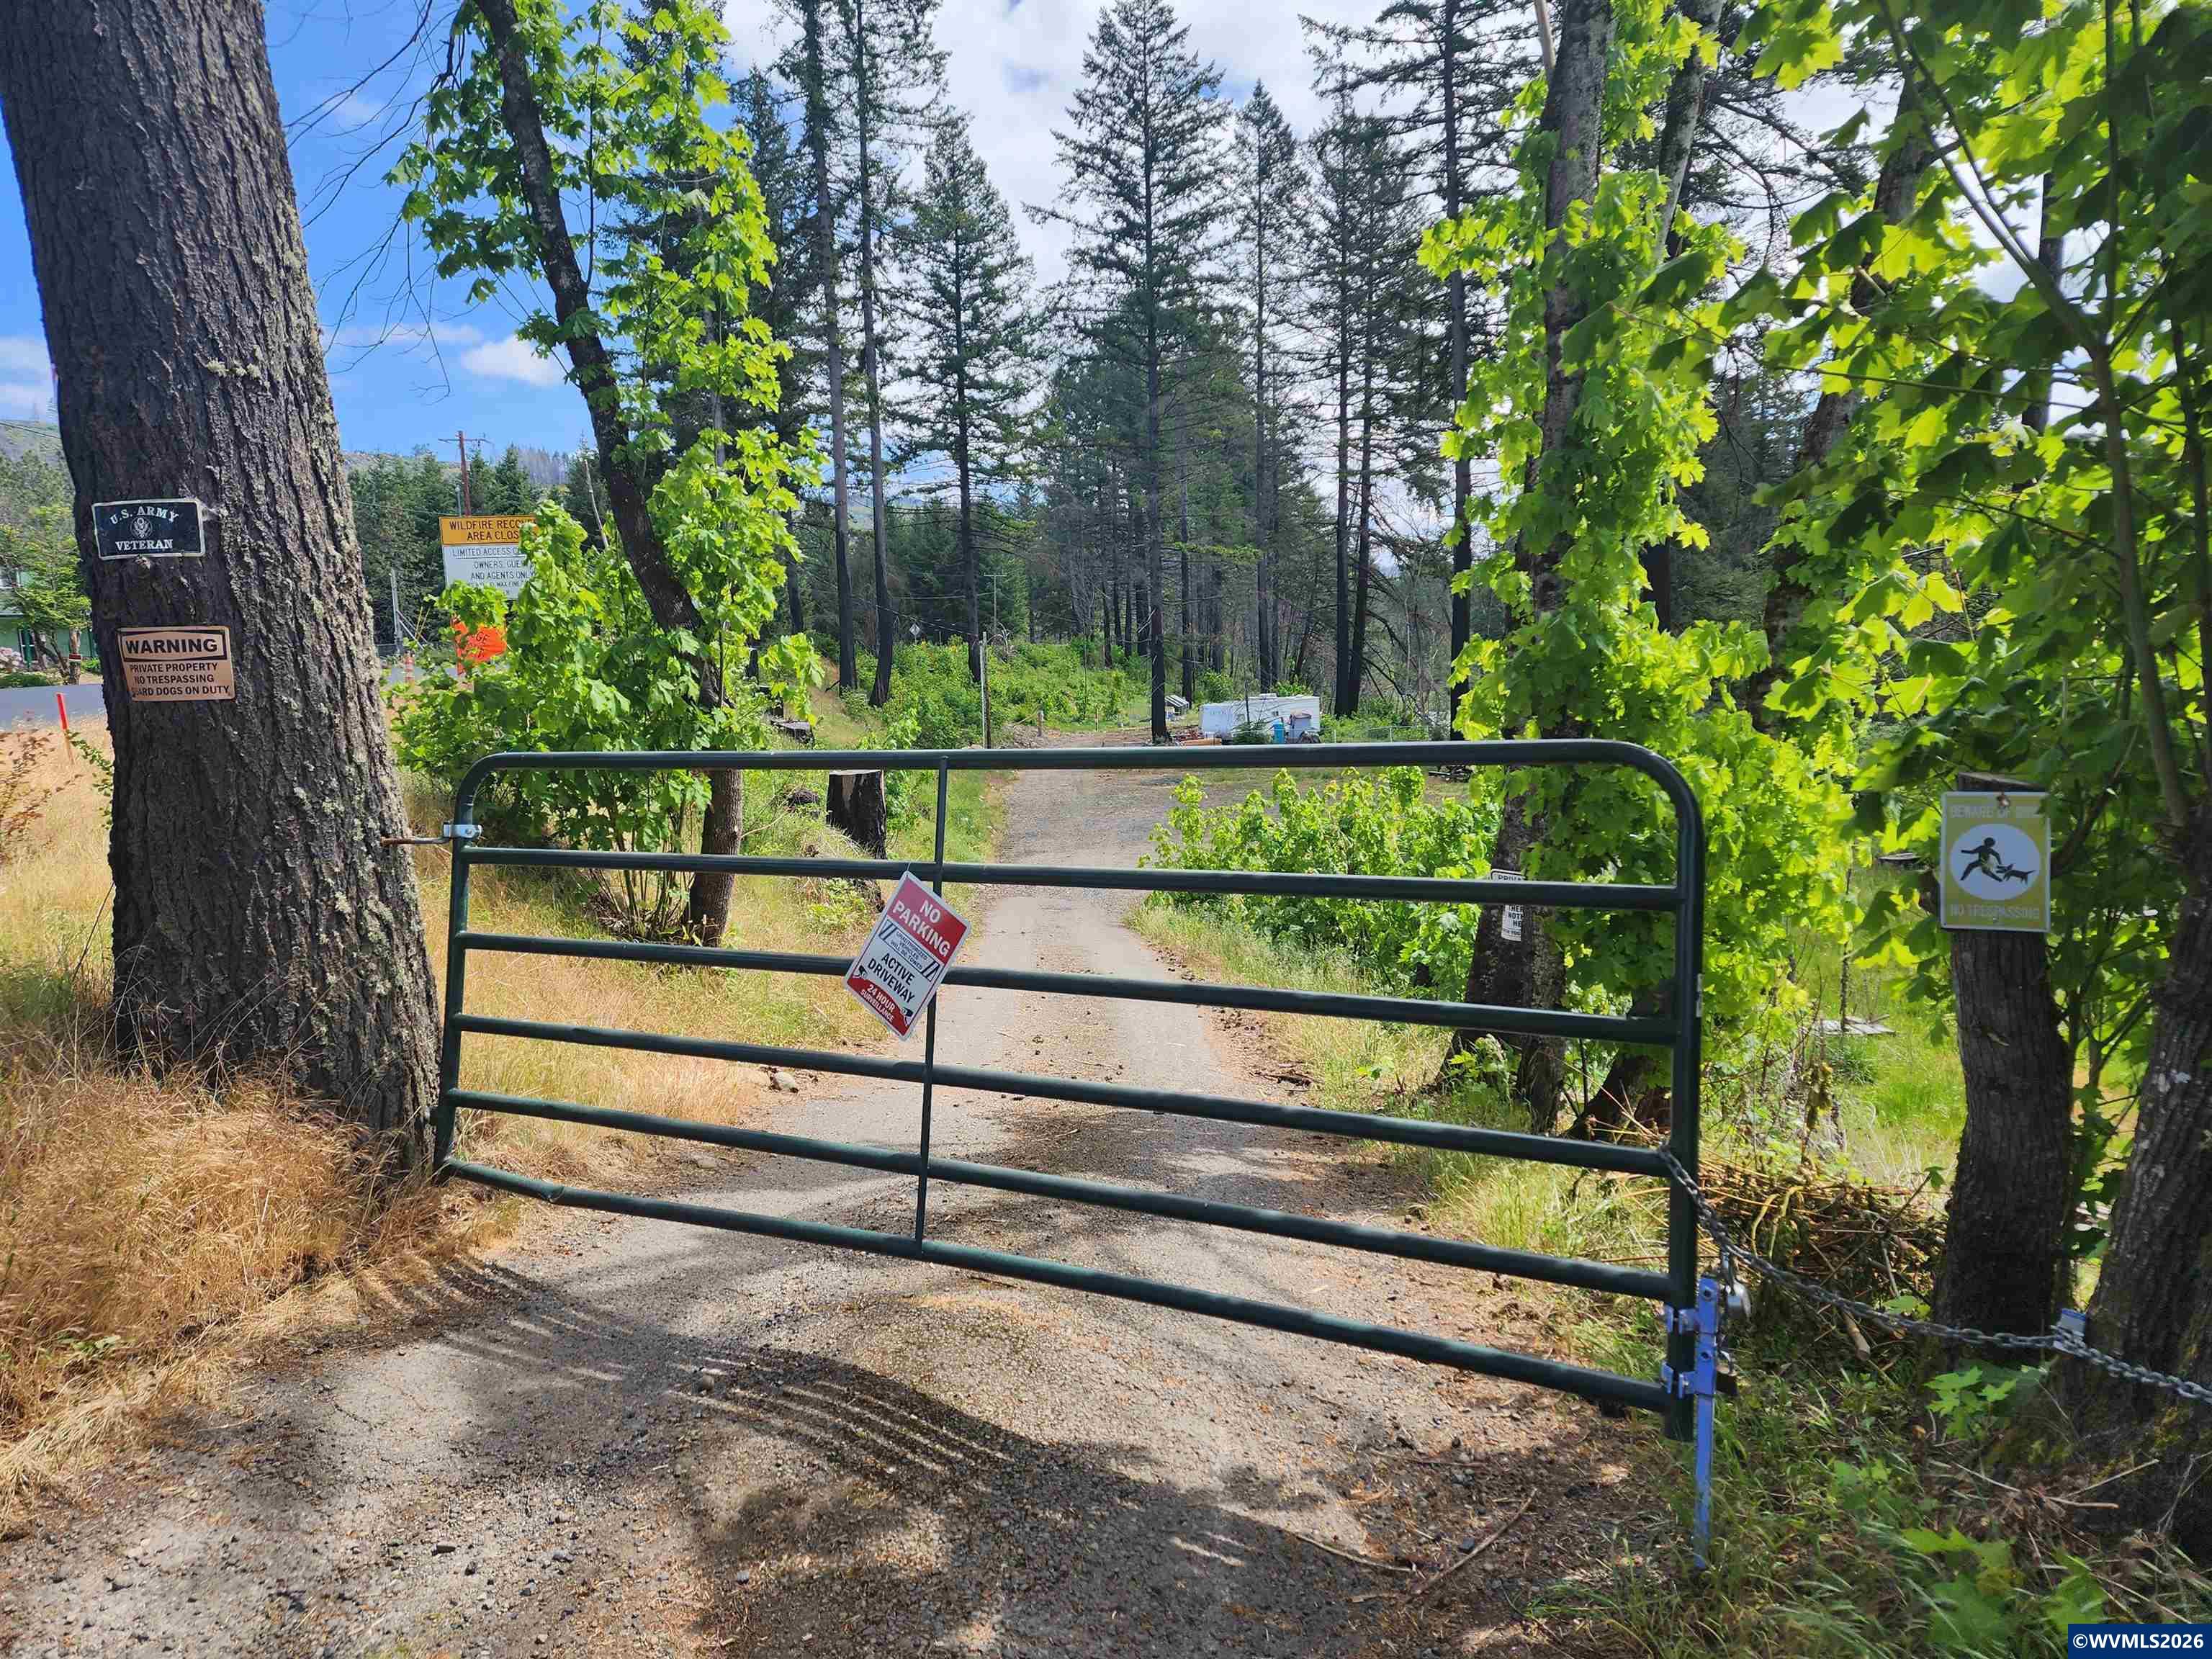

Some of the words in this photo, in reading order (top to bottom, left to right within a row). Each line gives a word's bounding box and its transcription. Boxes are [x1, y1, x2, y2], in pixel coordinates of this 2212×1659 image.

[110, 509, 132, 524] U.S.
[137, 506, 179, 522] ARMY
[449, 521, 494, 530] WILDFIRE
[497, 518, 536, 529] RECO
[467, 531, 493, 541] AREA
[495, 530, 519, 540] CLOS
[115, 539, 173, 551] VETERAN
[452, 548, 481, 557] LIMITED
[487, 571, 514, 580] AGENTS
[125, 638, 218, 654] WARNING
[130, 663, 163, 673] PRIVATE
[166, 662, 217, 672] PROPERTY
[147, 674, 215, 684] TRESPASSING
[156, 686, 183, 696] DOGS
[184, 686, 201, 695] ON
[202, 685, 230, 694] DUTY
[920, 900, 941, 923] NO
[892, 900, 950, 957] PARKING
[881, 953, 915, 985] ACTIVE
[868, 958, 915, 1003] DRIVEWAY
[866, 984, 878, 996] 24
[876, 991, 896, 1012] HOUR
[860, 989, 895, 1022] SURVEILLANCE
